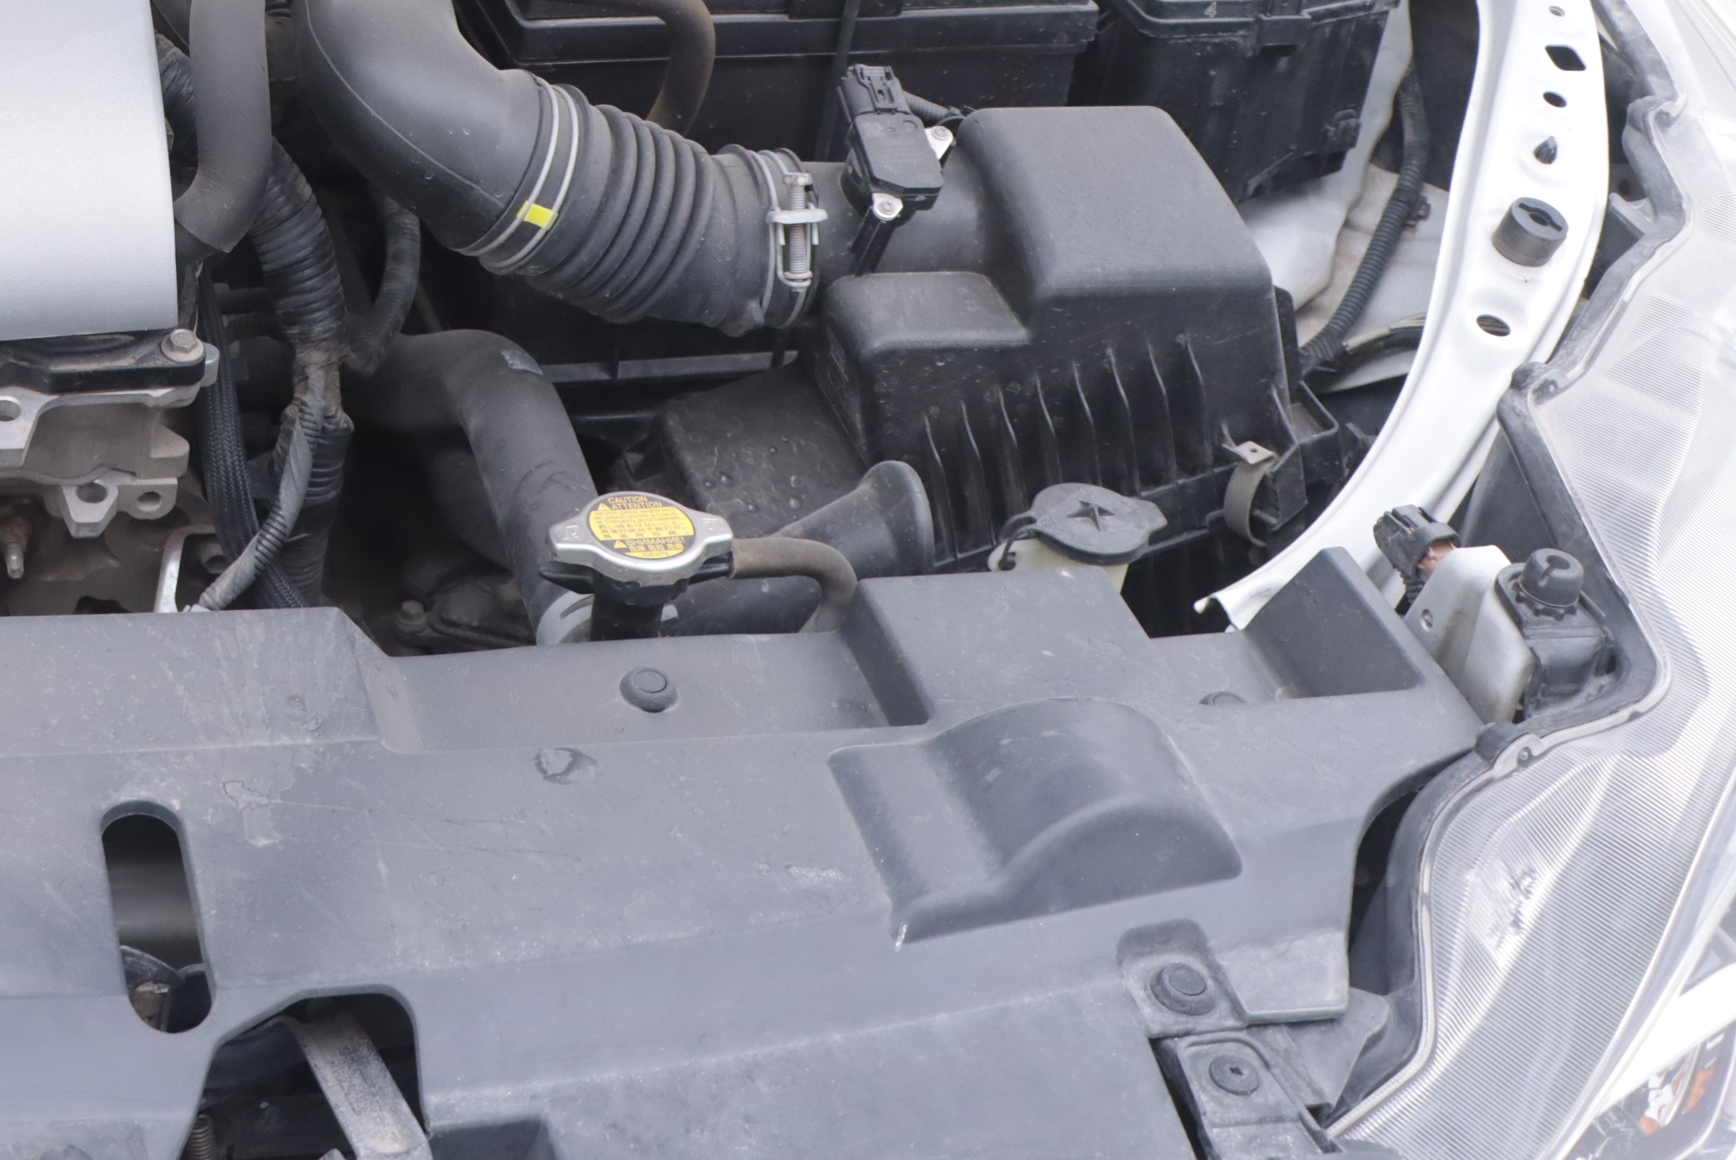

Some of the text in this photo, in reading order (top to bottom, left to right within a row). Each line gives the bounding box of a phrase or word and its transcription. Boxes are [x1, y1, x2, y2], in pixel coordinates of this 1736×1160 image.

[1204, 1, 1218, 18] 4
[607, 495, 648, 504] CAUTION
[611, 501, 663, 511] ATTENTION
[625, 536, 685, 546] ВНИМАНИЕ!
